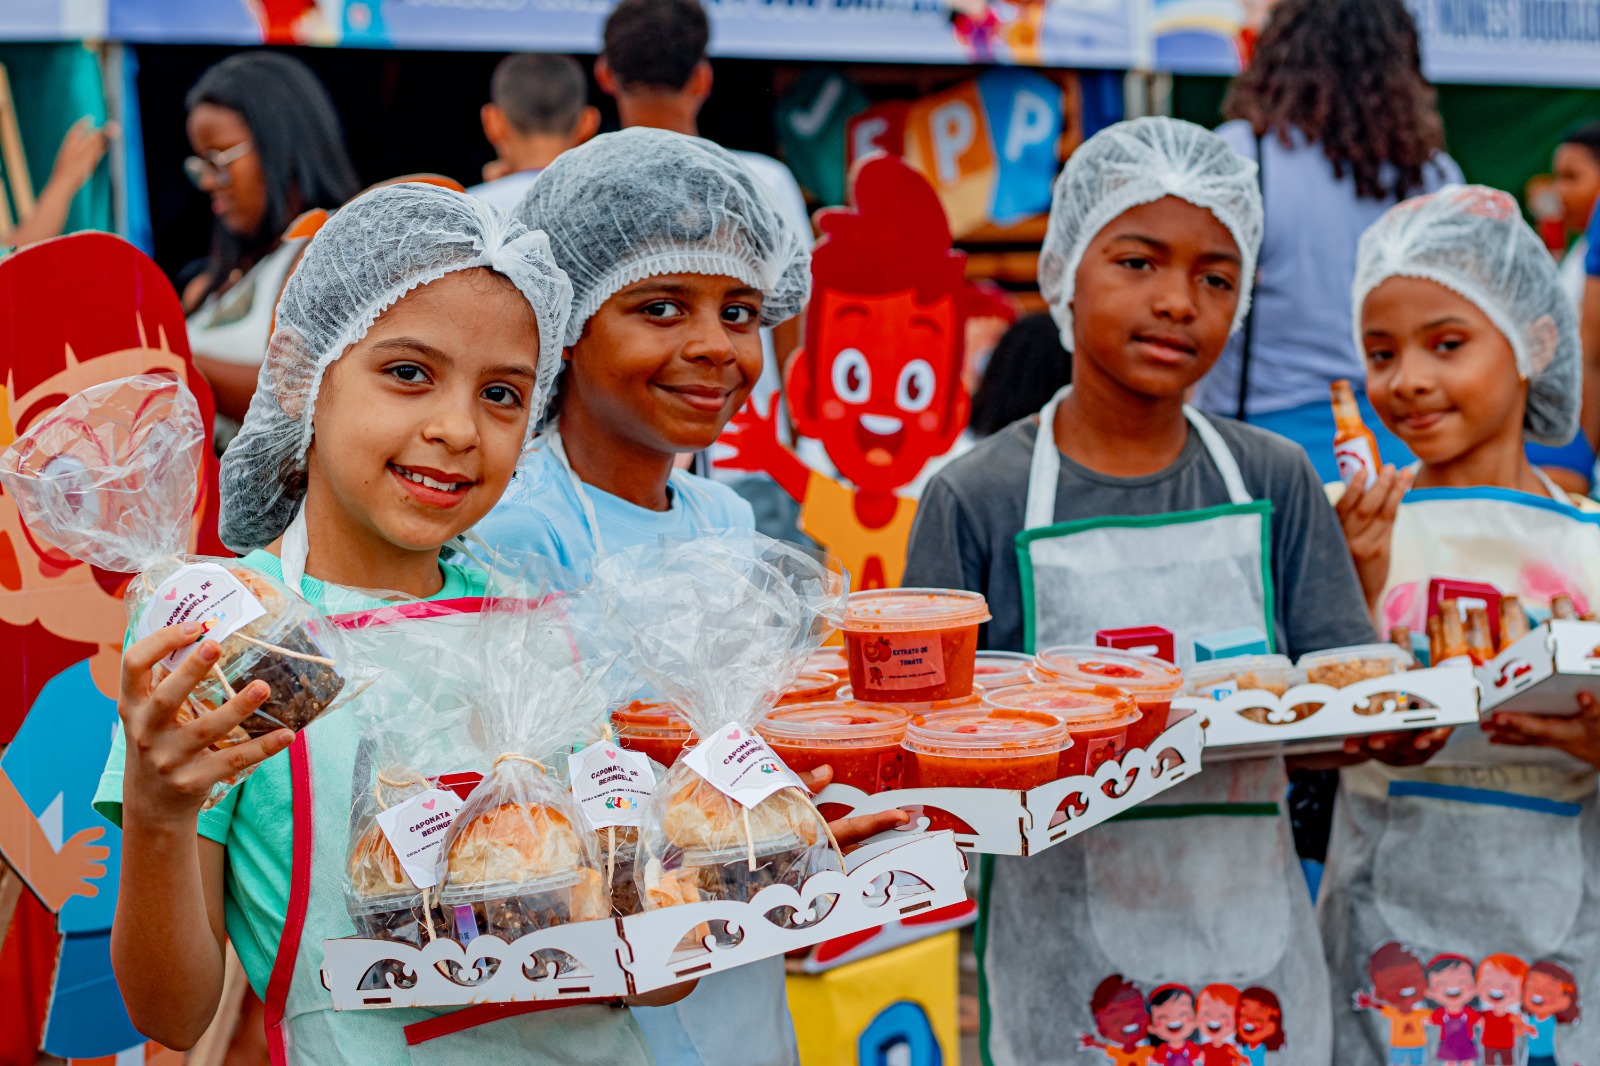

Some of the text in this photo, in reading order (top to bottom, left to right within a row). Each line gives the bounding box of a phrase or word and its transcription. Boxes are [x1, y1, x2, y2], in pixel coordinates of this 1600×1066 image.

[163, 592, 196, 628] APONATA
[200, 581, 212, 590] DE
[176, 594, 209, 624] ERINGELA
[893, 648, 919, 656] EXTRATO
[900, 658, 923, 666] TOMATE
[591, 764, 625, 780] CAPONATA
[598, 773, 634, 786] BERINGELA
[409, 811, 451, 833] CAPONATA
